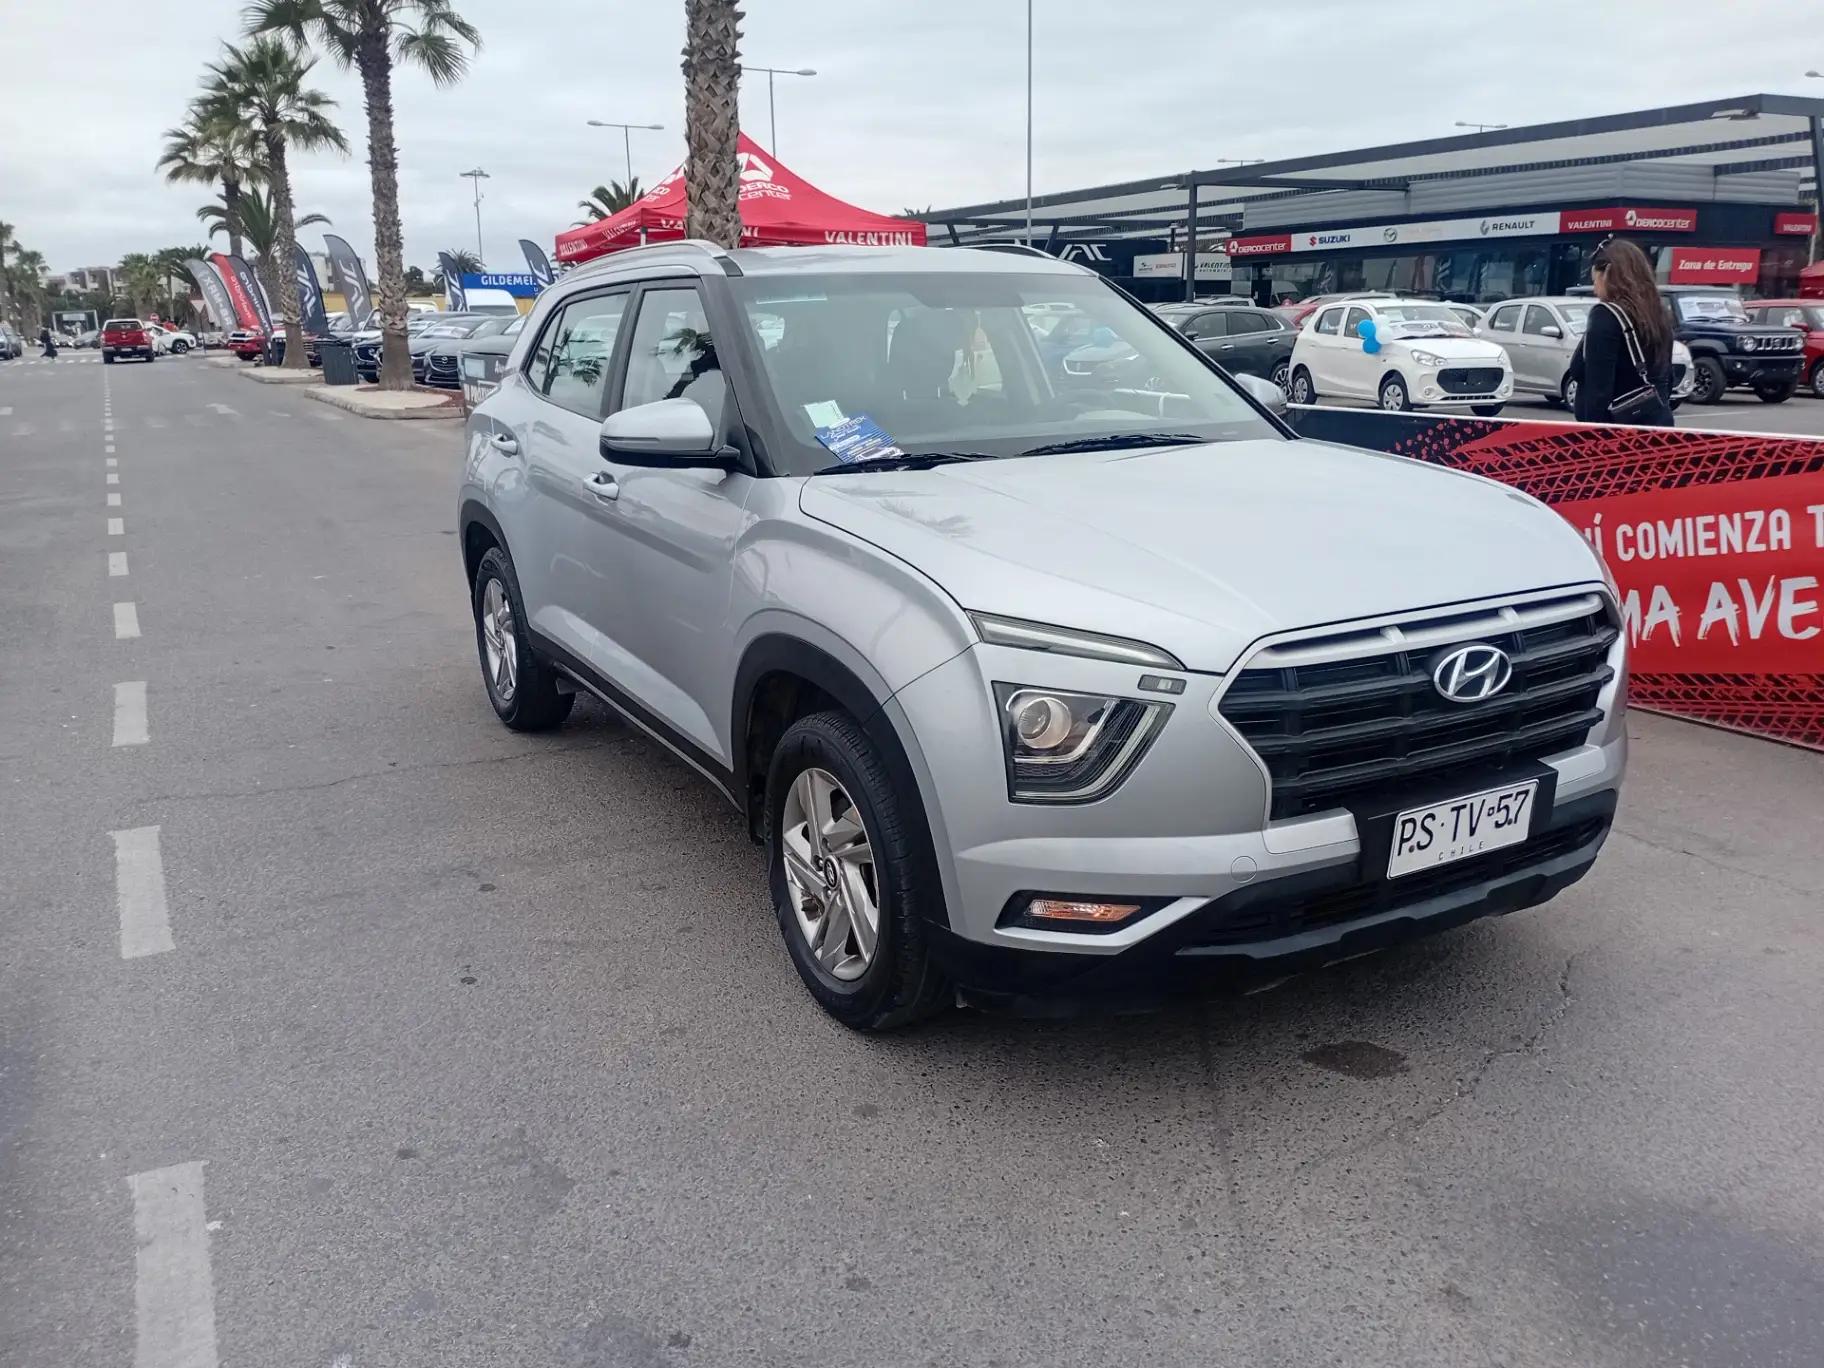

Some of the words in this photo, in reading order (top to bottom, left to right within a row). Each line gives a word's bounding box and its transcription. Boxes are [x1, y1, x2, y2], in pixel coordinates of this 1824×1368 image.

[1492, 220, 1536, 231] RENAULT
[1568, 219, 1613, 229] VALENTINI
[824, 230, 913, 246] VALENTINI
[1318, 233, 1350, 245] SUZUKI
[1678, 259, 1702, 271] Zona
[1703, 259, 1716, 270] de
[1717, 259, 1753, 273] Entrega
[481, 275, 537, 286] GILDEMEI
[1615, 508, 1792, 562] COMIENZA
[1438, 840, 1484, 861] CHILE
